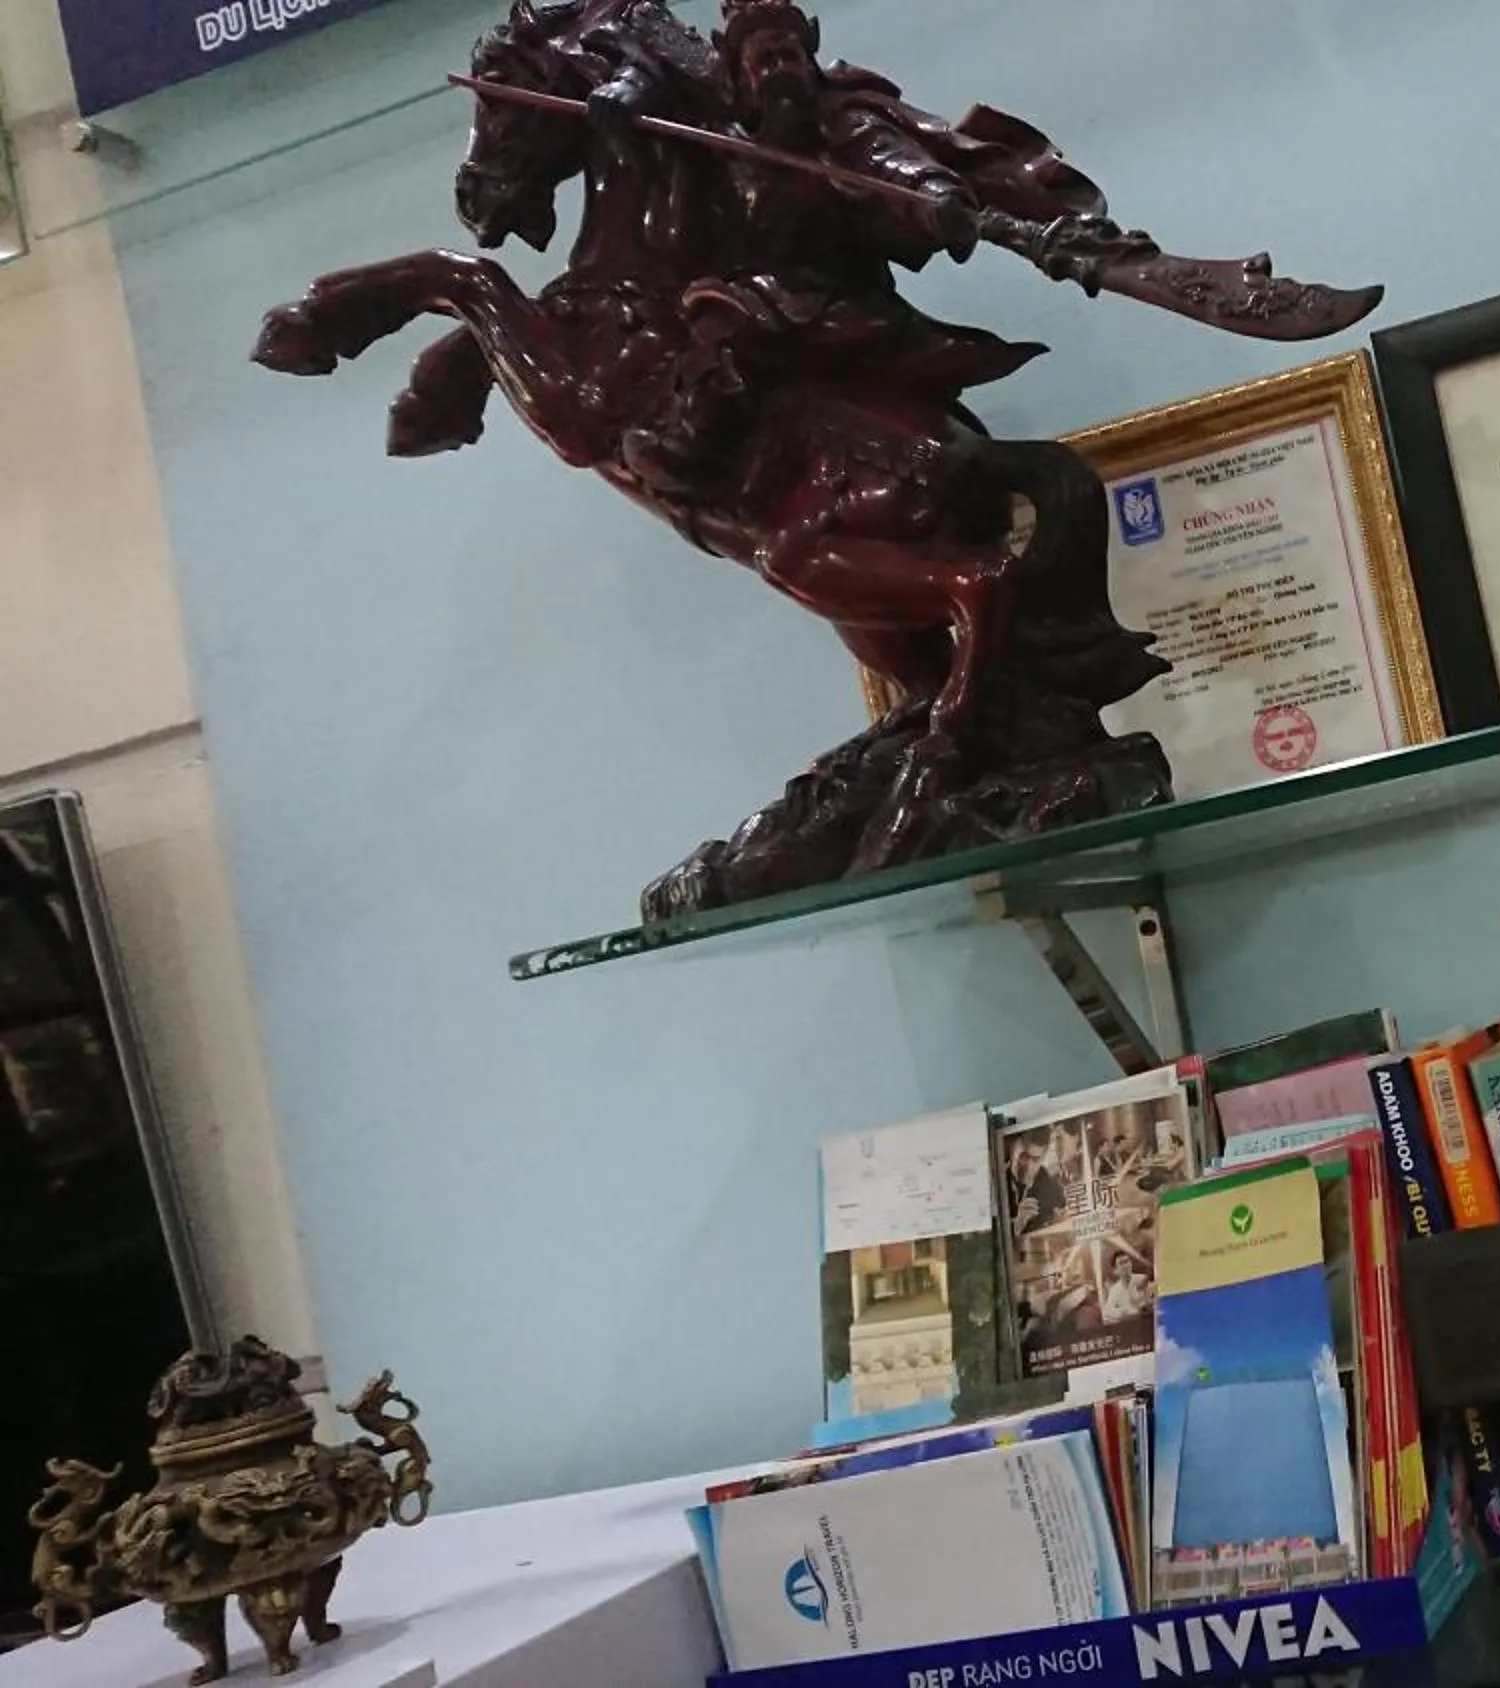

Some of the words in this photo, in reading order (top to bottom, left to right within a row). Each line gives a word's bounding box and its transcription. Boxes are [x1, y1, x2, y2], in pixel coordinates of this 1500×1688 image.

[195, 2, 247, 51] DU
[1377, 1071, 1400, 1121] ADAM
[1391, 1119, 1414, 1172] KHOO
[818, 1514, 836, 1553] TRAVEL
[830, 1555, 848, 1602] HORIZON
[1130, 1593, 1361, 1682] NIVEA
[963, 1654, 1032, 1688] RẠNG
